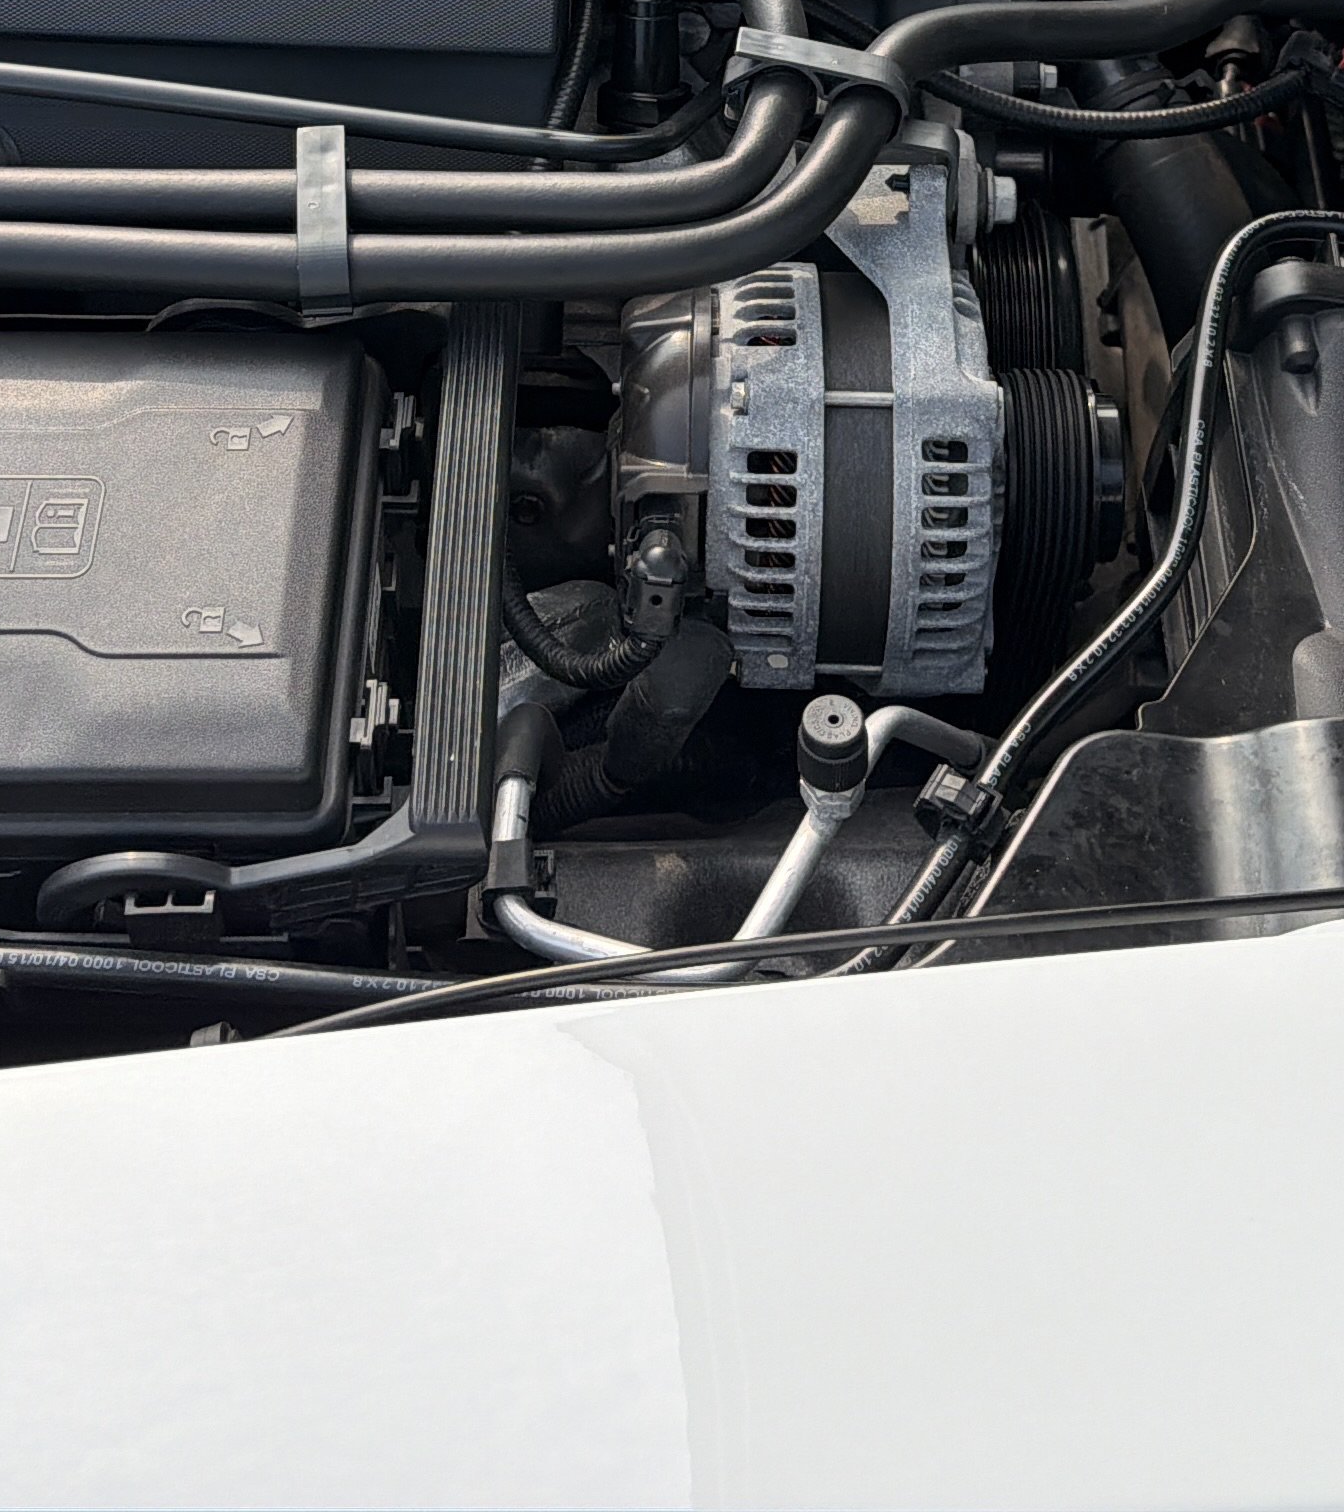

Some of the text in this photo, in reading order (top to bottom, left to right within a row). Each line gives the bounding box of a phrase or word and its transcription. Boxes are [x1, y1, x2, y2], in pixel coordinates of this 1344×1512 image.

[8, 952, 77, 968] 04/10/15
[83, 956, 122, 969] 1000
[134, 958, 236, 978] PLASTICOOL
[245, 967, 280, 981] CSA
